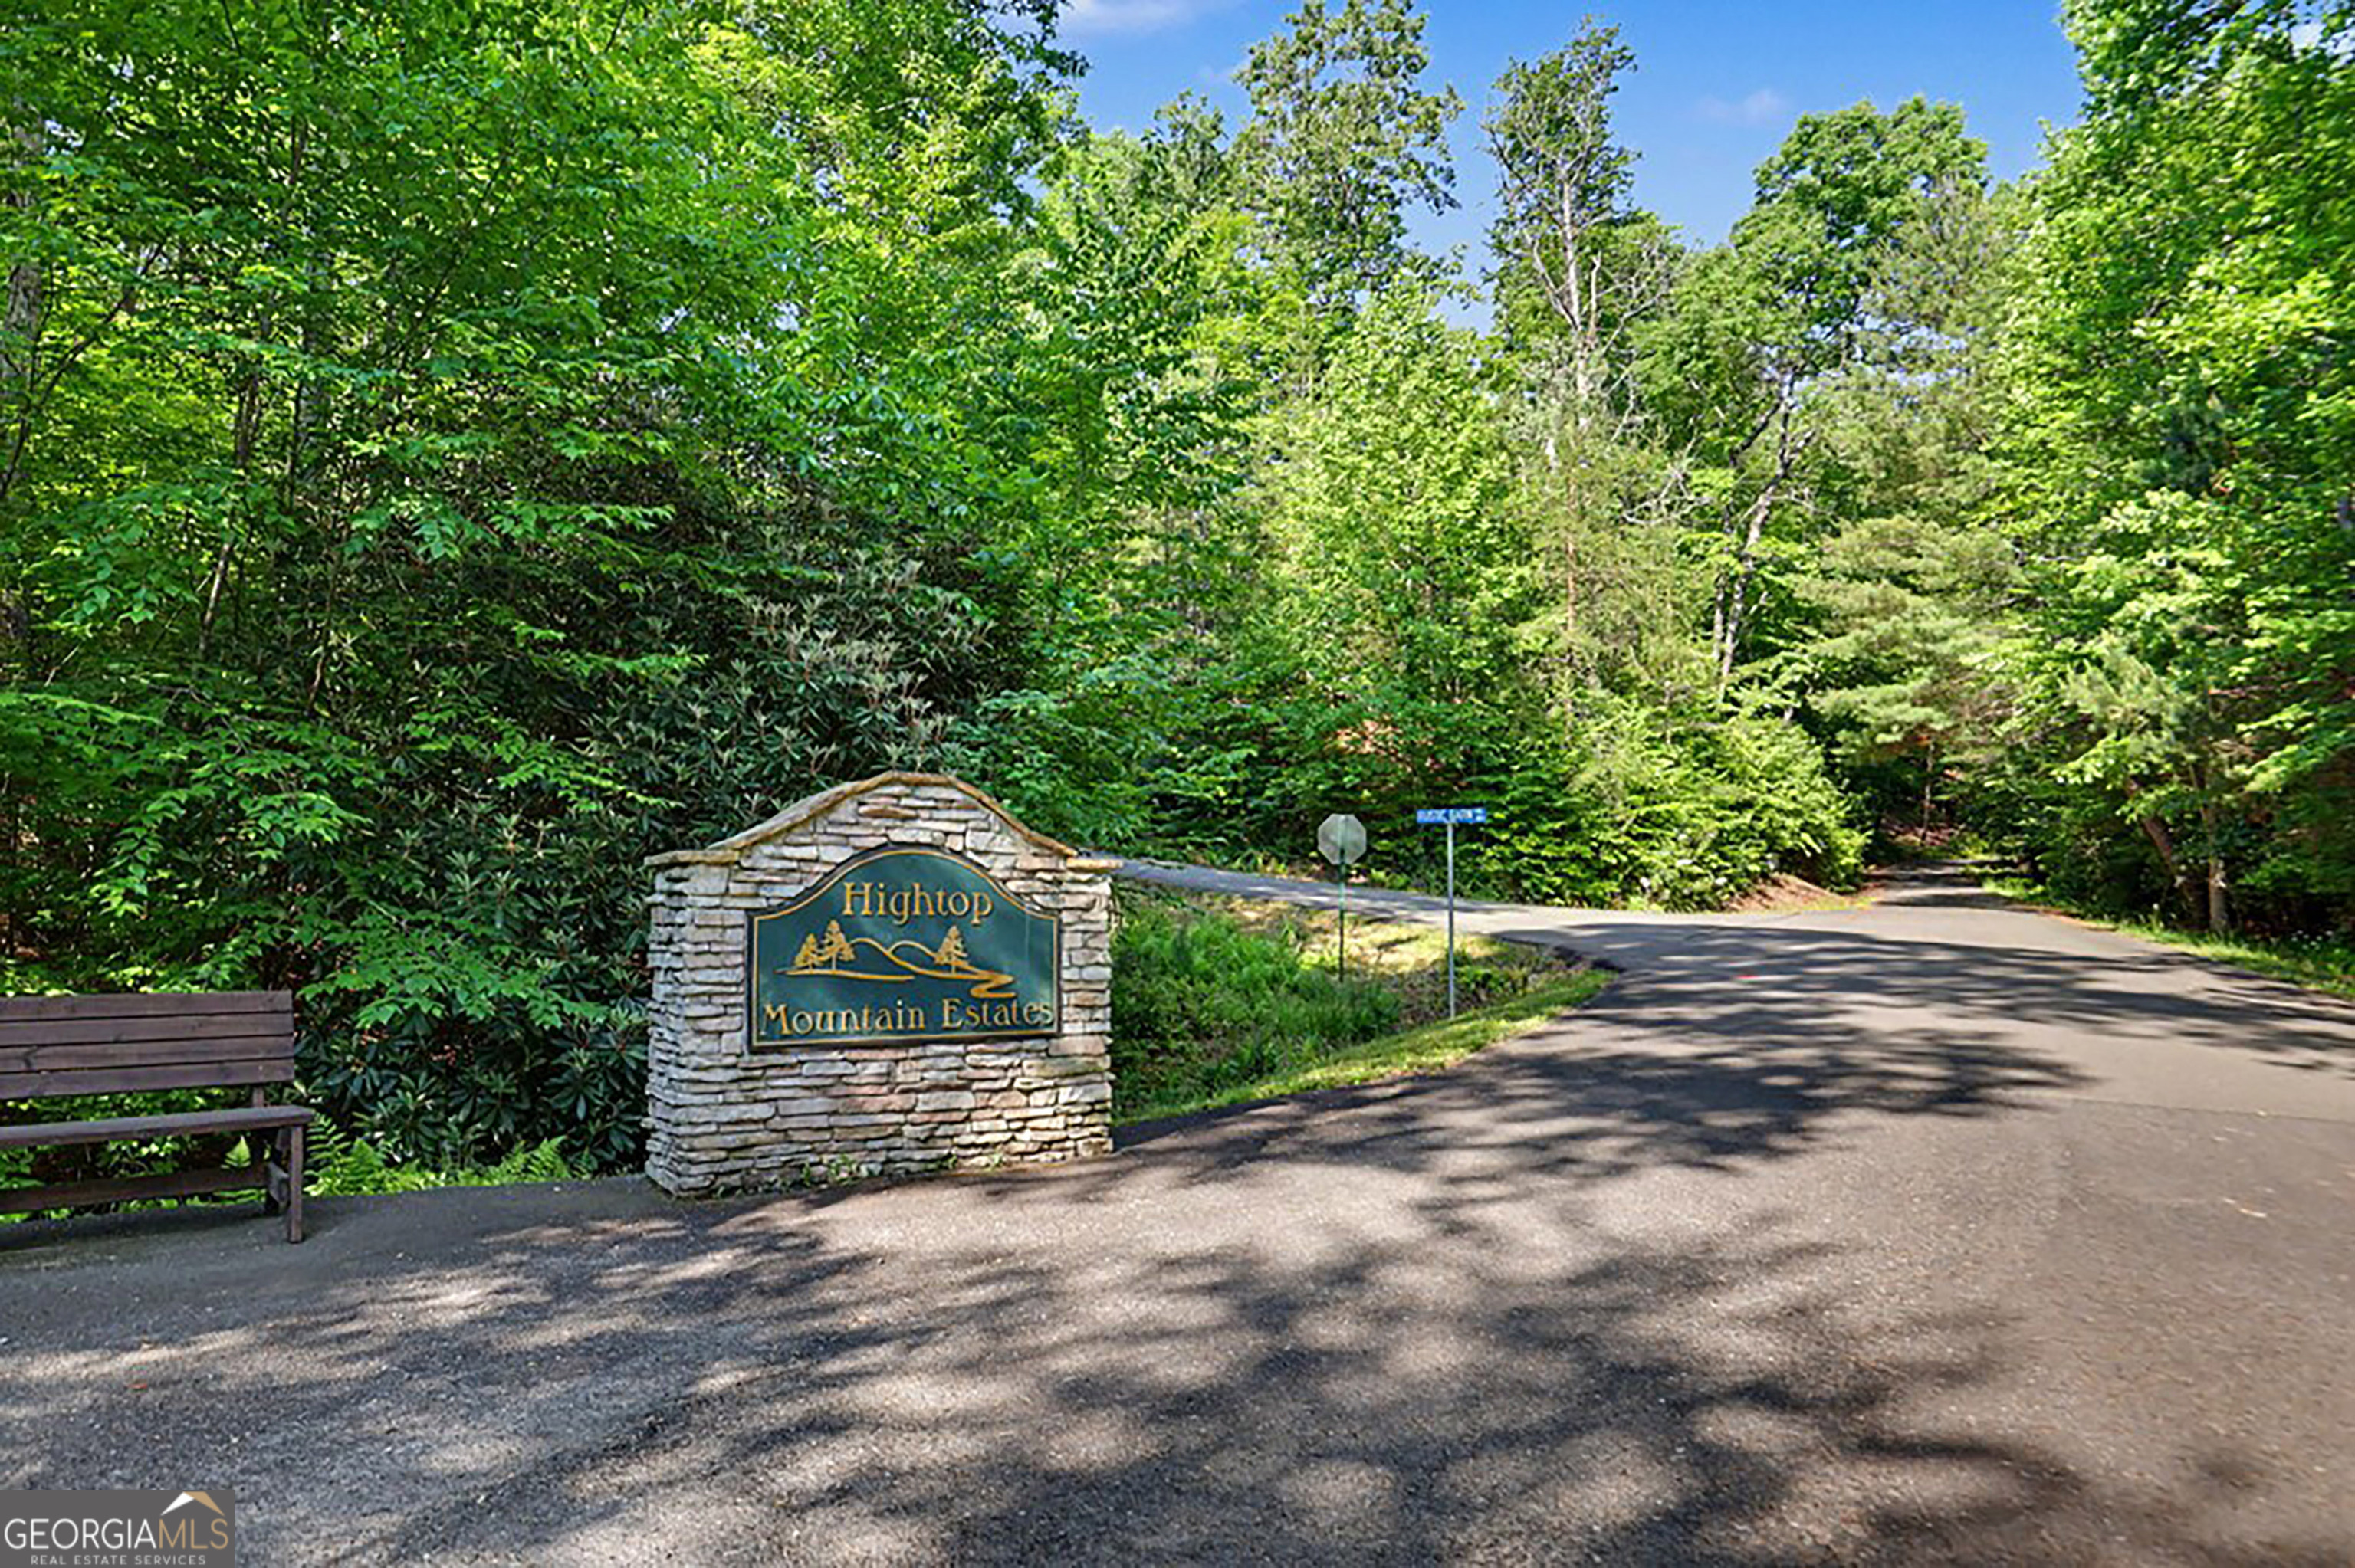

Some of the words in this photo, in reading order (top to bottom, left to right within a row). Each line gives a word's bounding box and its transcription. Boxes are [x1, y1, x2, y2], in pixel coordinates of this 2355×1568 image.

[842, 882, 994, 926] Hightop
[762, 999, 926, 1035] Mountain
[941, 998, 1054, 1029] Estates
